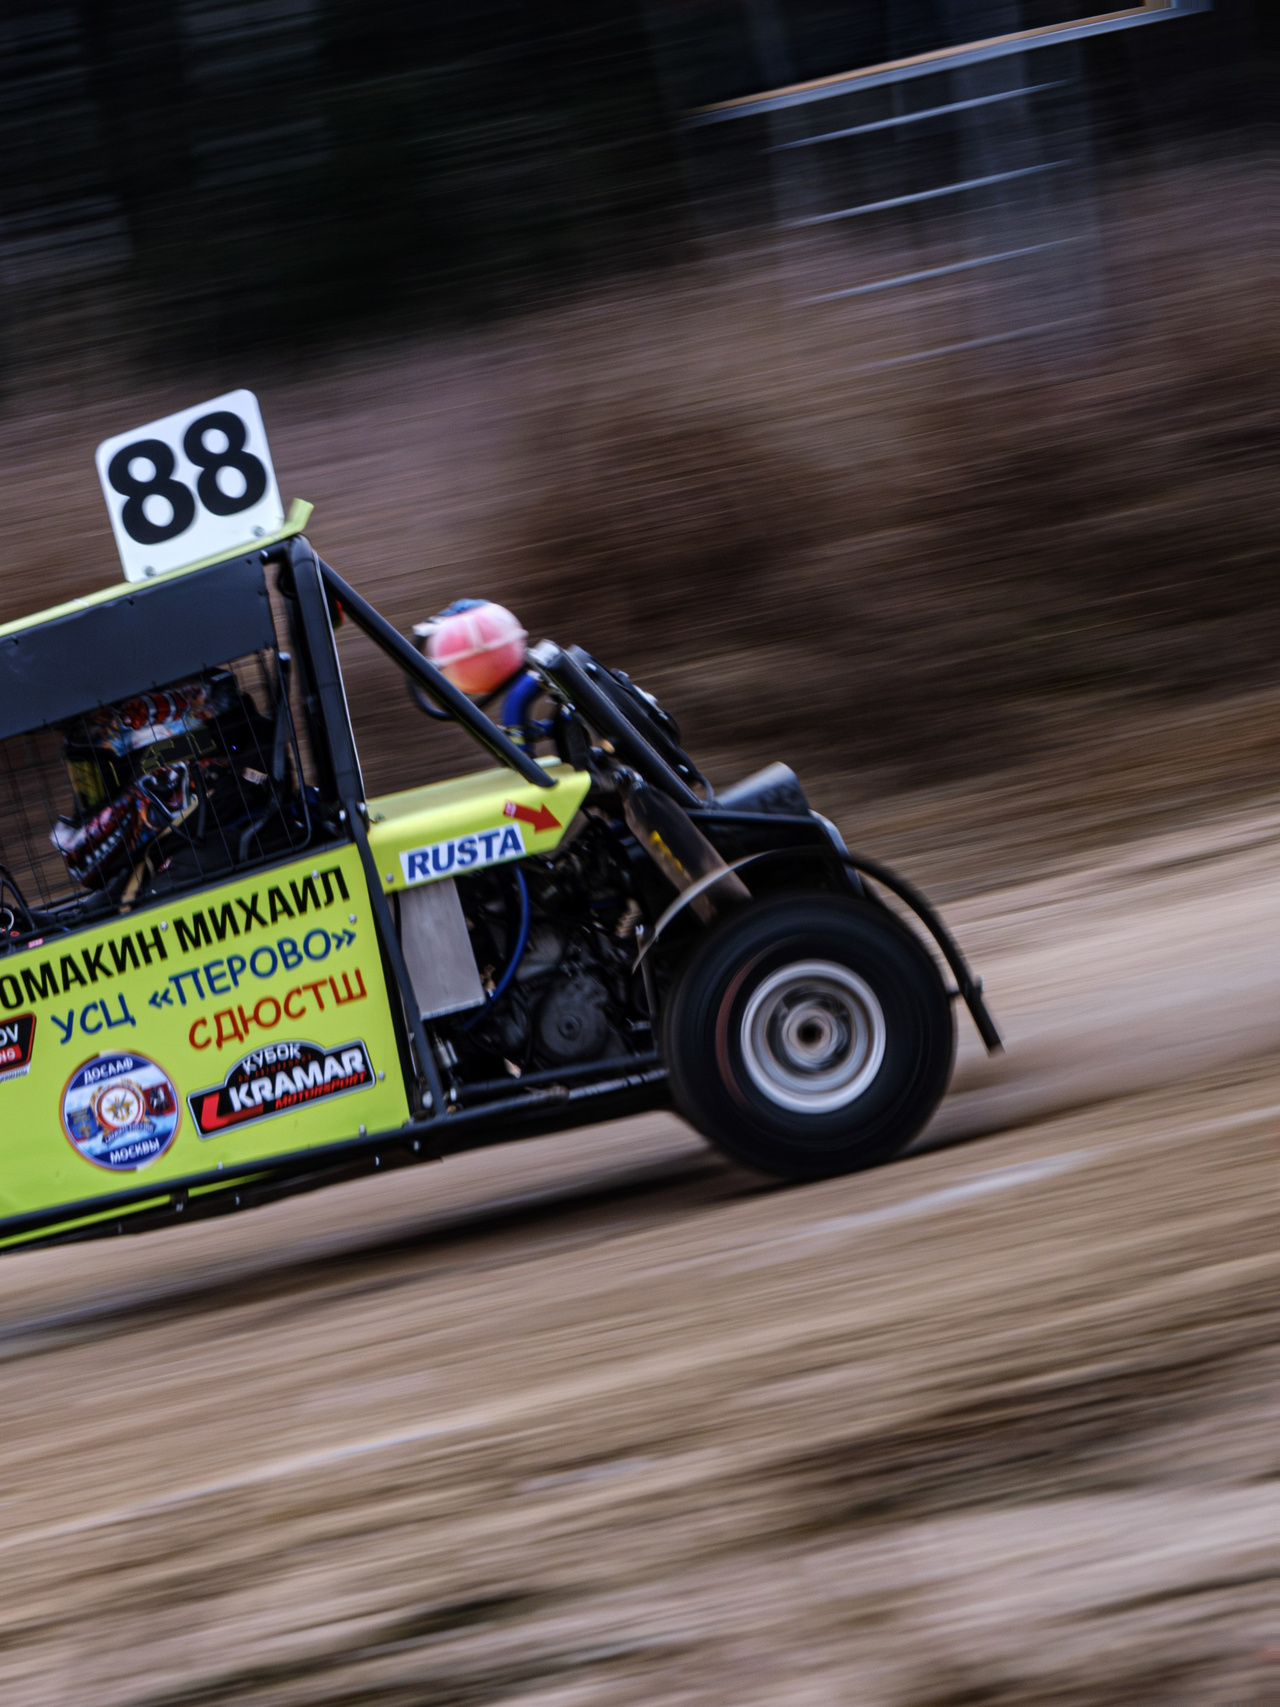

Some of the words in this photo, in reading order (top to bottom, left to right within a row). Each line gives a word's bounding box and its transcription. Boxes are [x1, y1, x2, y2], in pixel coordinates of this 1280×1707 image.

[108, 411, 267, 545] 88
[407, 825, 522, 880] RUSTA
[173, 866, 350, 954] МИХАИЛ
[50, 992, 136, 1045] УСЦ
[148, 928, 356, 1009] «ПЕРОВО»
[188, 967, 368, 1051] СДЮСТШ
[84, 1057, 133, 1085] ДОСААФ
[228, 1048, 367, 1113] KRAMAR
[241, 1043, 302, 1075] КУБОК
[110, 1137, 160, 1164] МОСКВЫ
